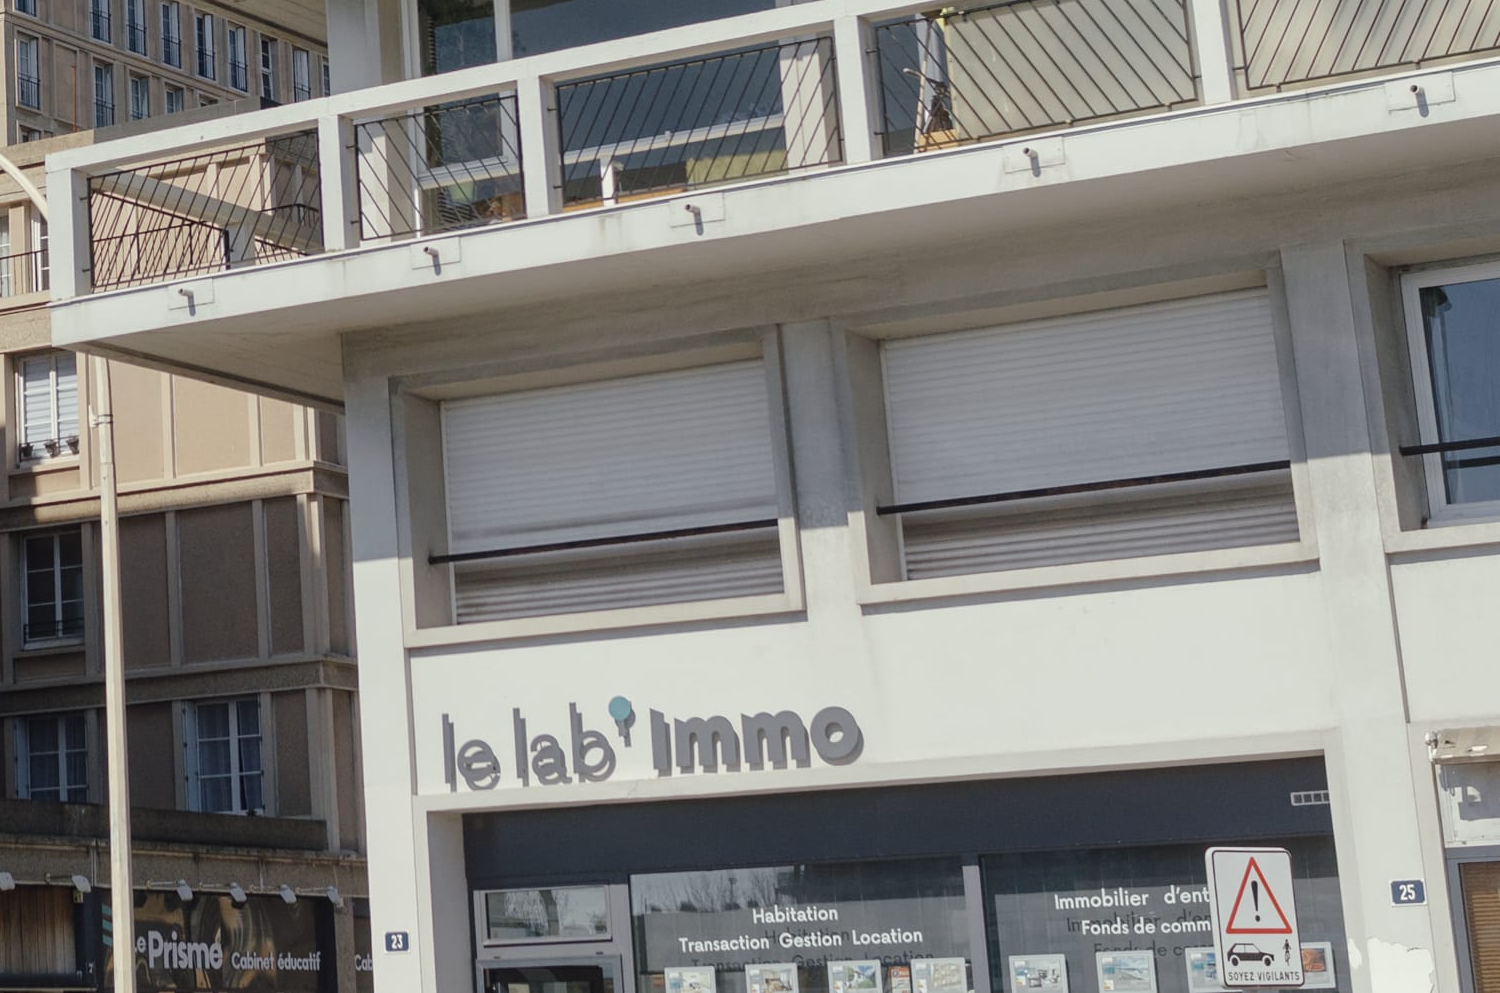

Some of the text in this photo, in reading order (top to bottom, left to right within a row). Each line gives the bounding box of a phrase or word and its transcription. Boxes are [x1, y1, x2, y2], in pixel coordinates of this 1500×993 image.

[442, 713, 499, 789] le
[1054, 887, 1149, 910] Immobilier
[1399, 884, 1416, 900] 25
[752, 904, 838, 924] Habitation
[1082, 915, 1211, 935] Fonds de comm
[390, 934, 403, 949] 23
[678, 928, 923, 953] Transaction Gestion Location
[134, 936, 147, 953] e
[231, 952, 275, 971] Cabinet
[277, 951, 322, 971] éducatif
[1228, 971, 1300, 981] SOYEZ VIGILANTS
